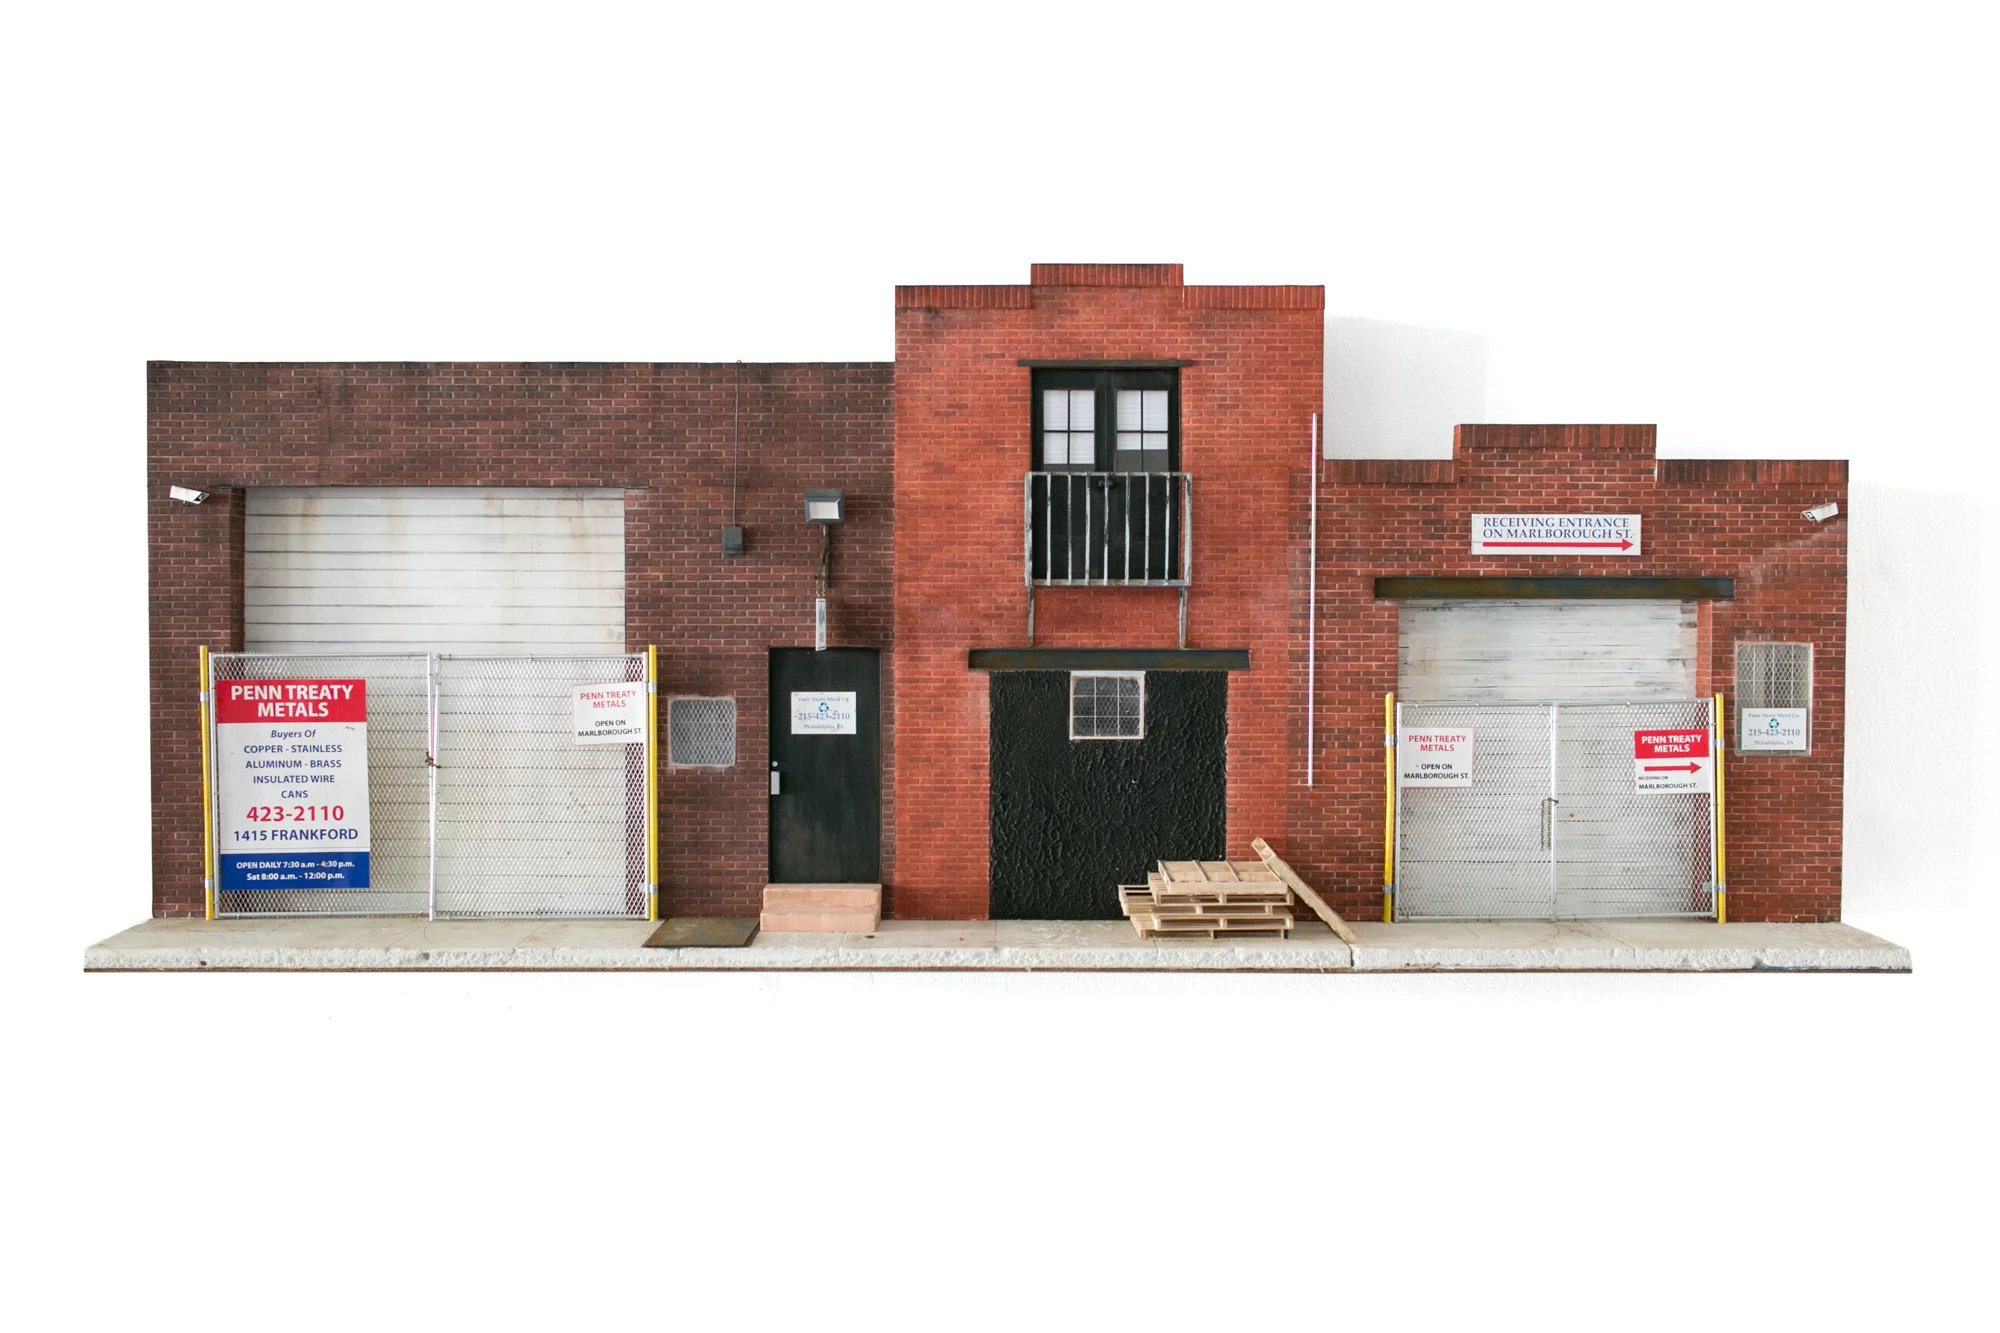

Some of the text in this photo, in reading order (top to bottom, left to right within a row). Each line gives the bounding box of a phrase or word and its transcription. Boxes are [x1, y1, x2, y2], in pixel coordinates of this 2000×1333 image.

[1484, 517, 1630, 527] RECEIVING ENTRANCE
[1483, 529, 1633, 539] ON MARLBOROUGH ST.
[231, 685, 353, 700] PENN TREATY
[606, 690, 637, 699] TREATY
[593, 700, 626, 708] METALS
[257, 702, 329, 718] METALS
[271, 729, 317, 740] Buyers Of
[1641, 735, 1702, 744] PENN TREATY
[244, 745, 283, 754] COPPER
[291, 744, 343, 753] STAINLESS
[1654, 744, 1690, 752] METALS
[245, 760, 302, 769] ALUMINUM
[310, 760, 342, 768] BRASS
[253, 775, 335, 784] INSULATED WIRE
[281, 790, 309, 799] CANS
[246, 805, 344, 822] 423-2110
[234, 828, 358, 841] 1415 FRANKFORD
